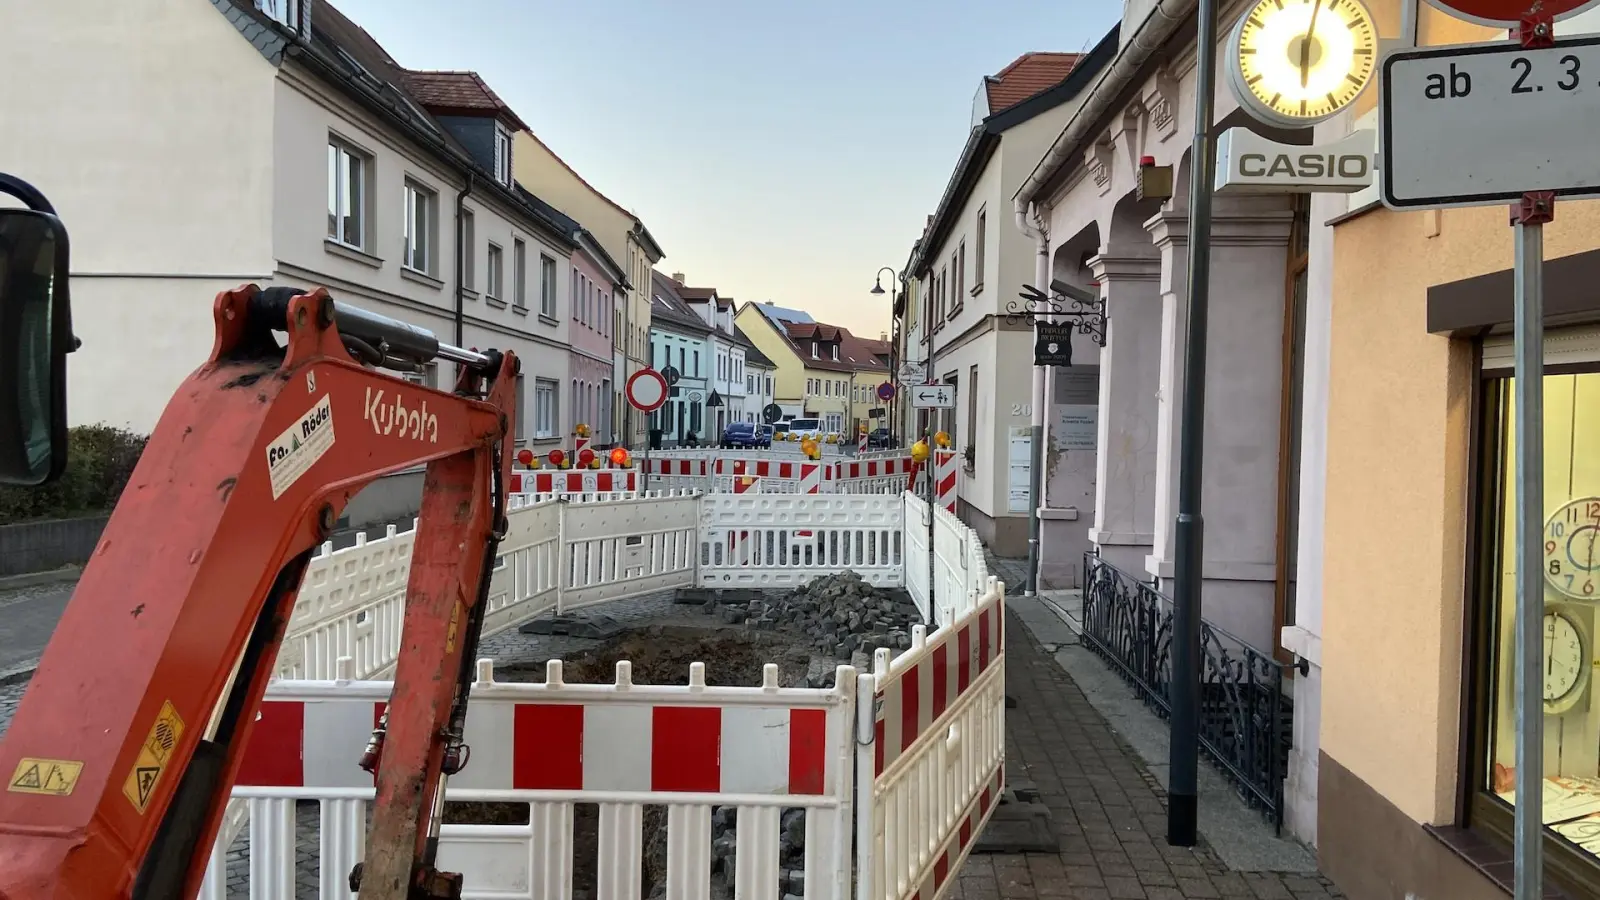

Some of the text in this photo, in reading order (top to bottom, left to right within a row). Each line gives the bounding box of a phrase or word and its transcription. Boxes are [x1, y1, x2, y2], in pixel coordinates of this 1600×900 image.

[1424, 62, 1472, 100] ab
[1239, 153, 1368, 178] CASIO
[364, 386, 438, 444] Kubota
[1011, 403, 1032, 417] 20
[301, 404, 330, 439] Röder
[1567, 507, 1578, 523] 11
[1551, 522, 1564, 538] 10
[1545, 540, 1557, 556] 9
[1549, 559, 1561, 575] 8
[1563, 574, 1575, 591] 7
[1582, 578, 1594, 595] 6
